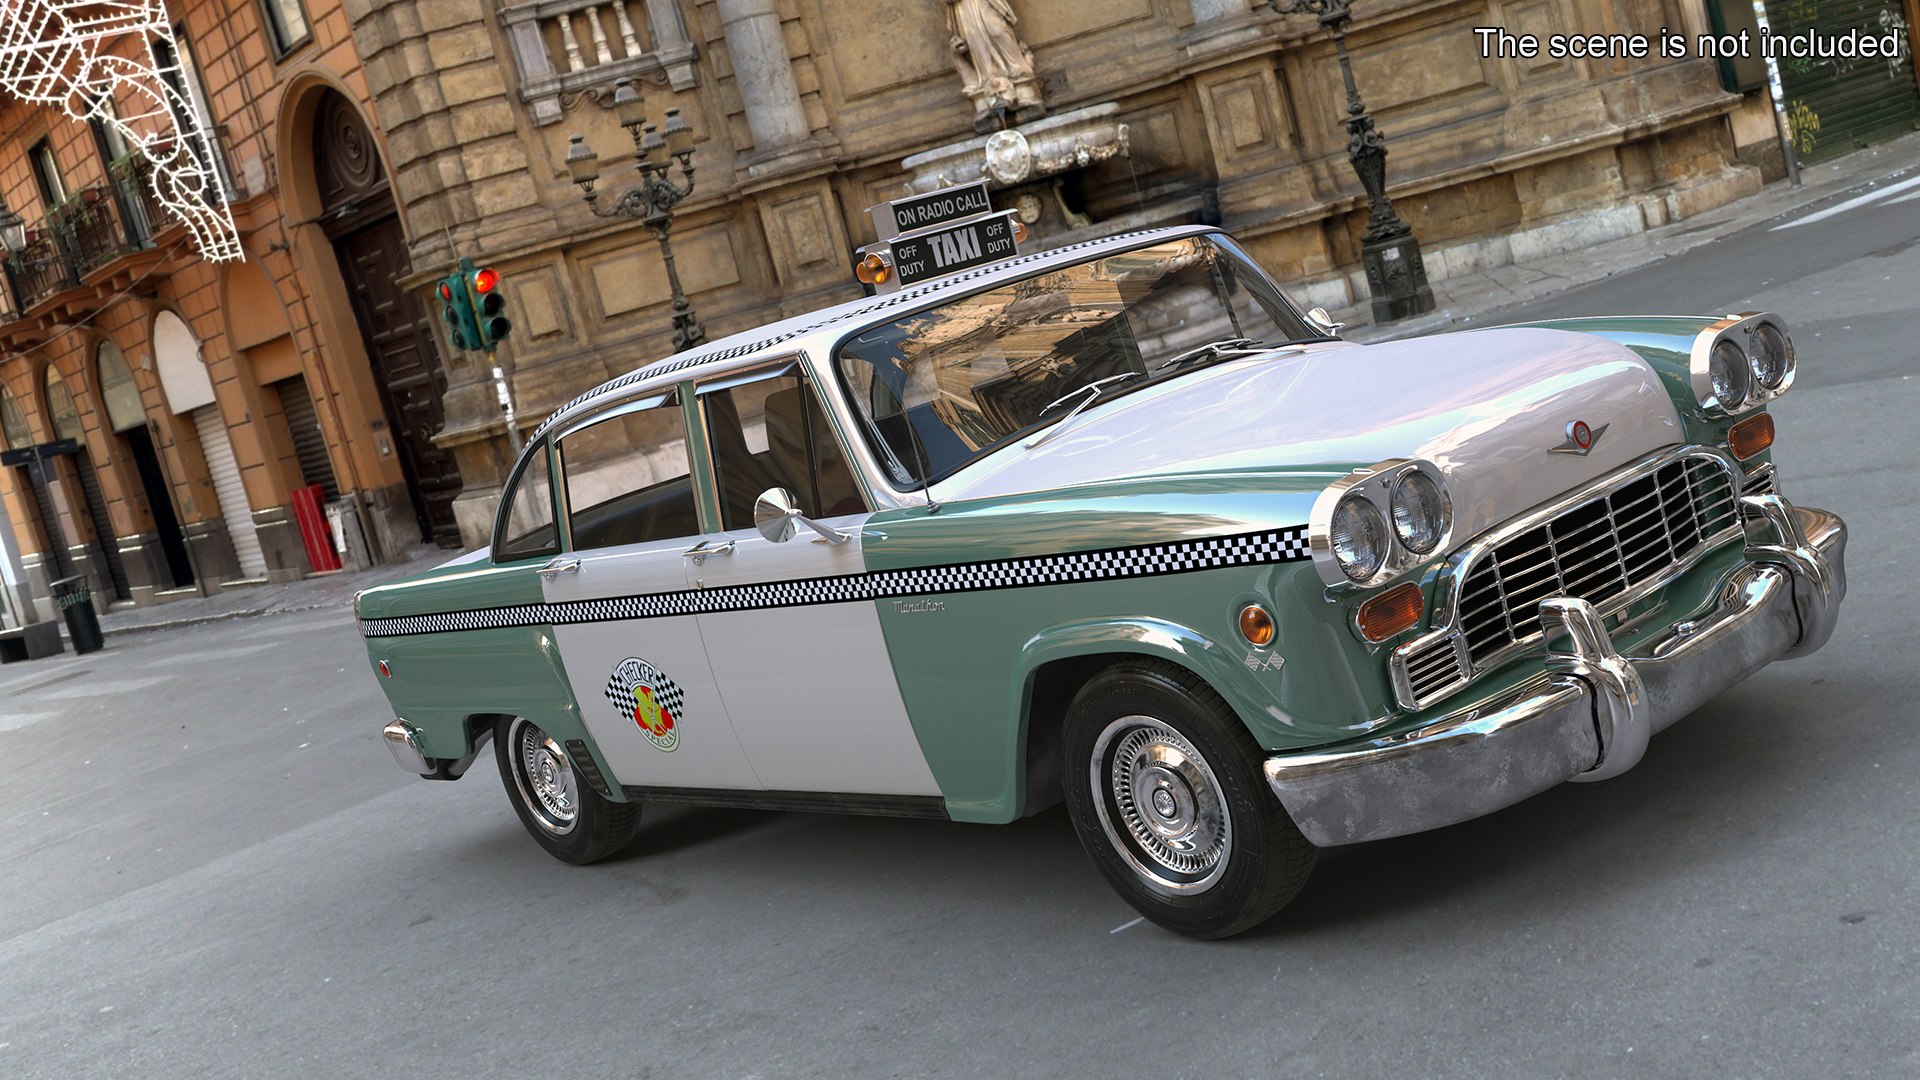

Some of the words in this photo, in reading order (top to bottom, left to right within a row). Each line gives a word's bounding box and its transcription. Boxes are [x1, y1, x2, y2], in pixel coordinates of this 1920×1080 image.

[897, 210, 916, 226] ON
[918, 199, 955, 221] RADIO
[956, 191, 987, 210] CALL
[986, 223, 1003, 237] OFF
[899, 245, 917, 260] OFF
[927, 226, 982, 268] TAXI
[987, 238, 1011, 254] DUTY
[900, 260, 925, 277] DUTY
[892, 599, 945, 613] Marathon
[619, 661, 654, 685] CHECKER
